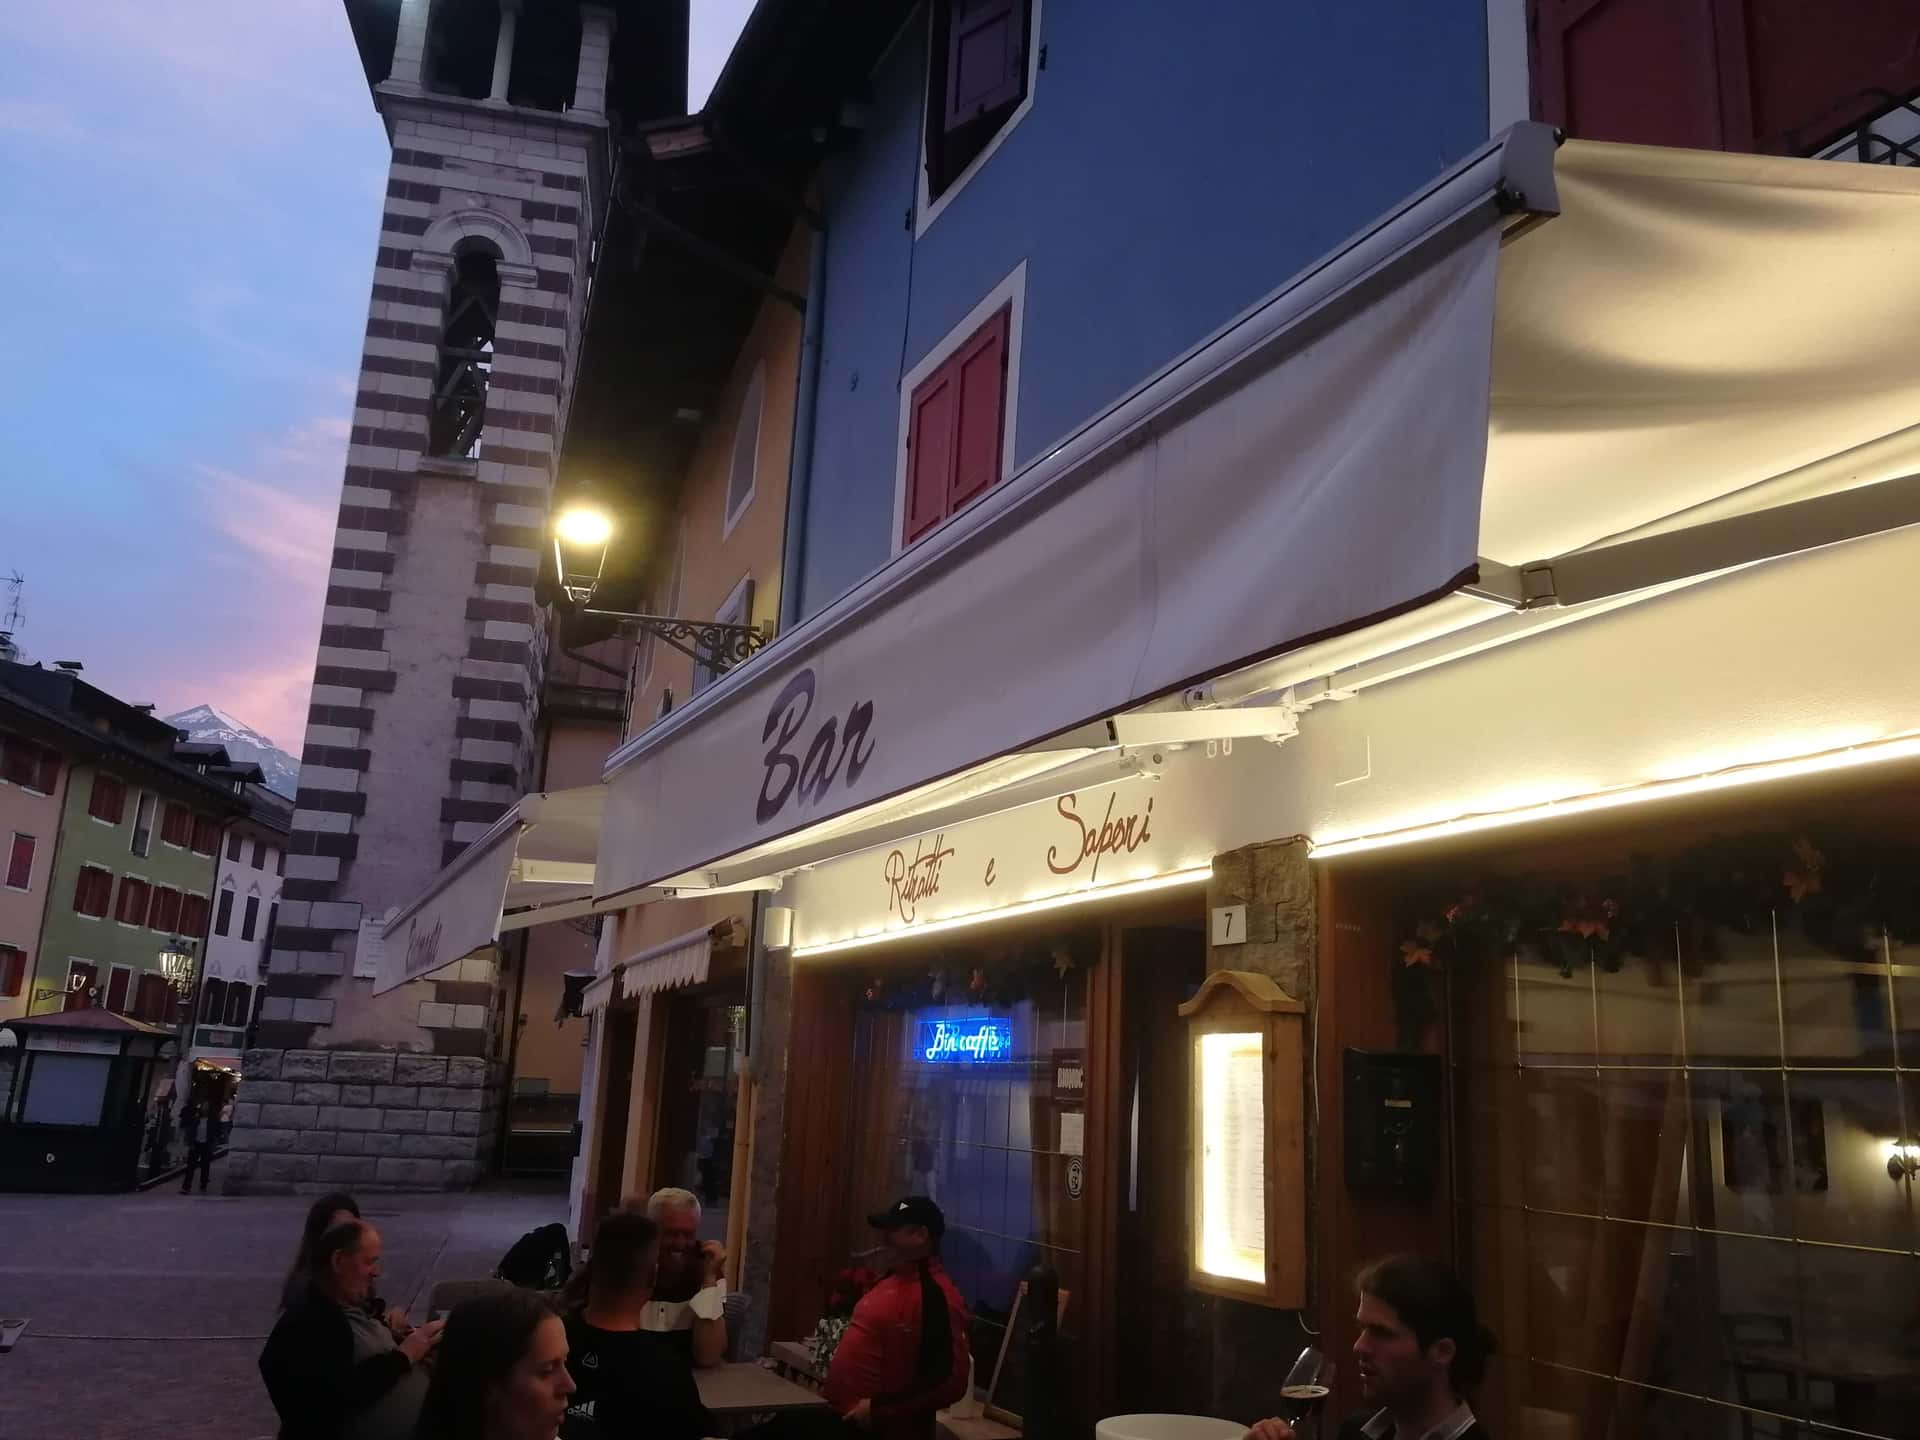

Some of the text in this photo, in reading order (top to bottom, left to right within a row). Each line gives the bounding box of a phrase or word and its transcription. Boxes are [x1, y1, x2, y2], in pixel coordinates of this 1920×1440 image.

[756, 668, 875, 825] Bar
[885, 792, 1153, 923] Ritratti e Sapori
[1224, 912, 1233, 938] 7
